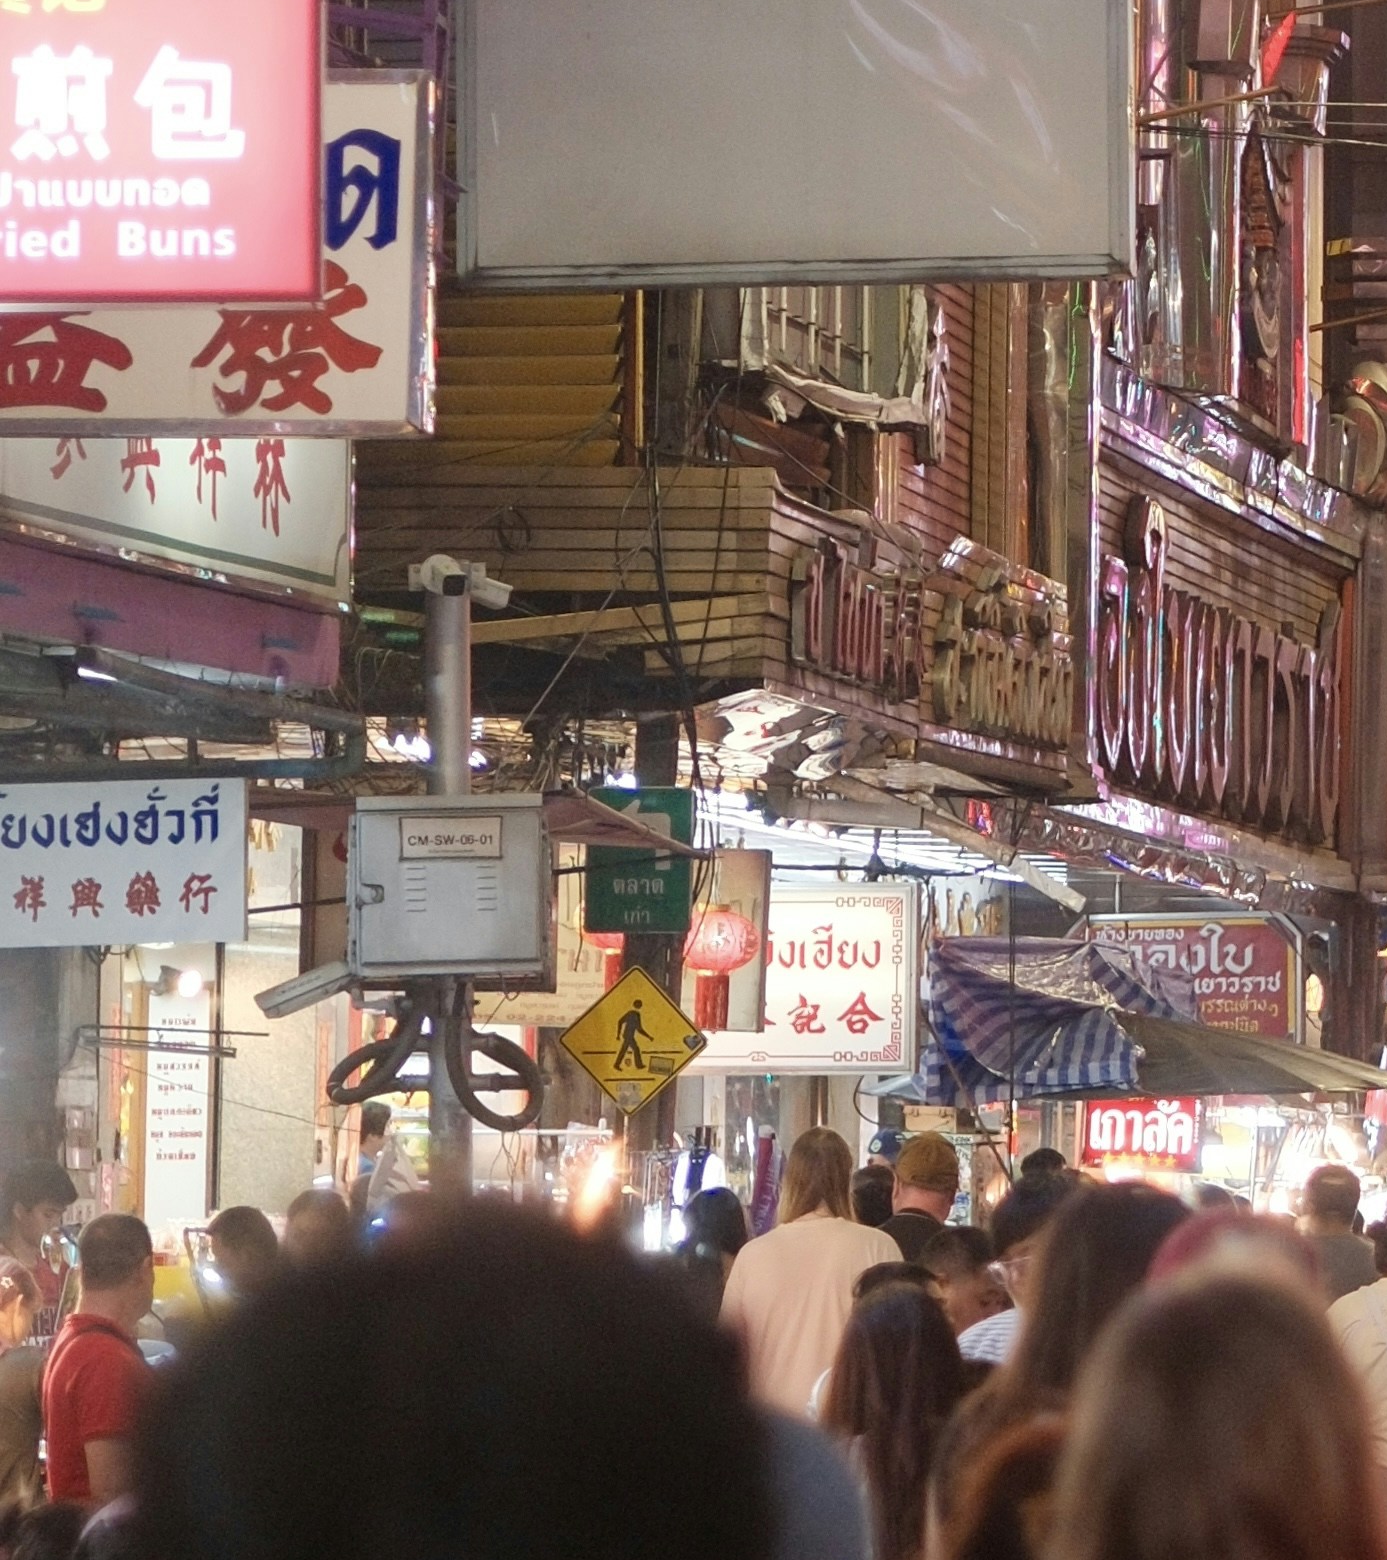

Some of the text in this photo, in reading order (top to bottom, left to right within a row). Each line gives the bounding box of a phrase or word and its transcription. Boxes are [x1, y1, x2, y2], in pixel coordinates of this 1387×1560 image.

[0, 218, 237, 259] ied Buns
[407, 834, 494, 847] CM-SW-06-01
